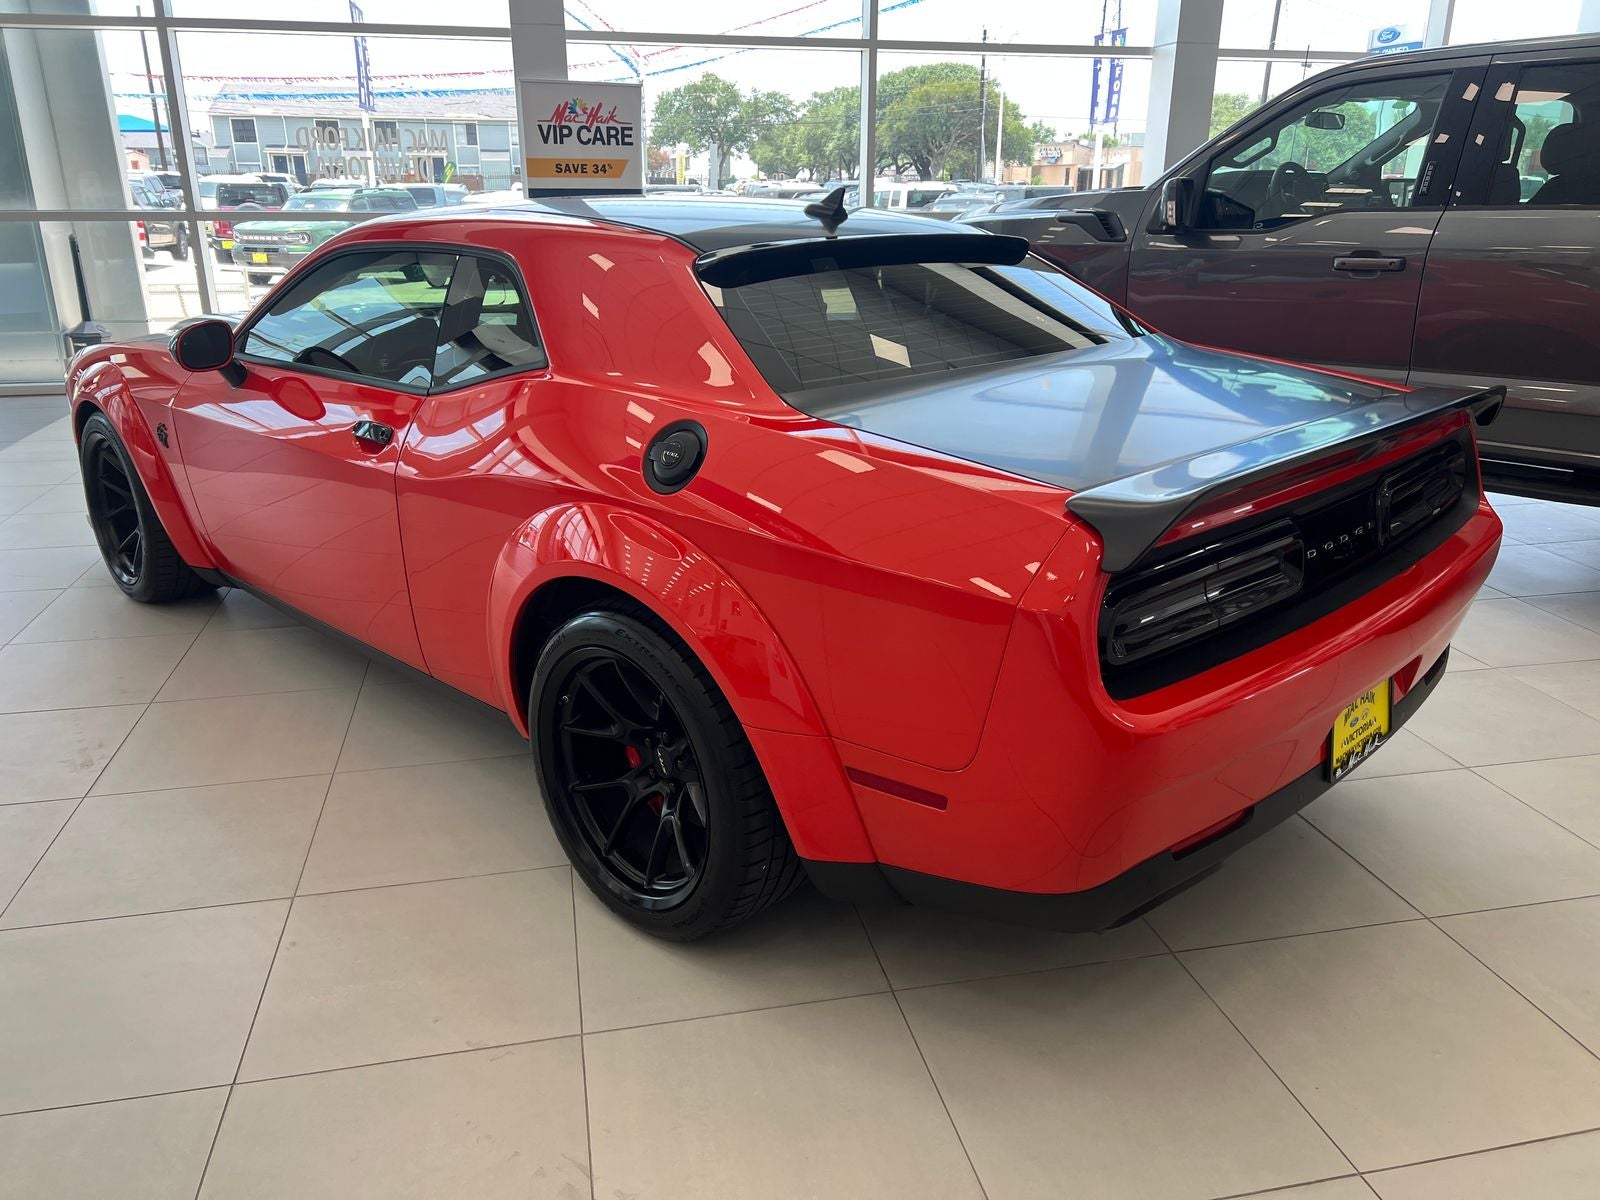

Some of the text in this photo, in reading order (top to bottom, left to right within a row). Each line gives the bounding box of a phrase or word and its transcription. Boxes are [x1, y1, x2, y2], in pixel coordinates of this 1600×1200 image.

[538, 101, 632, 128] Mac Haik
[537, 124, 633, 146] VIP CARE
[555, 163, 588, 174] SAVE
